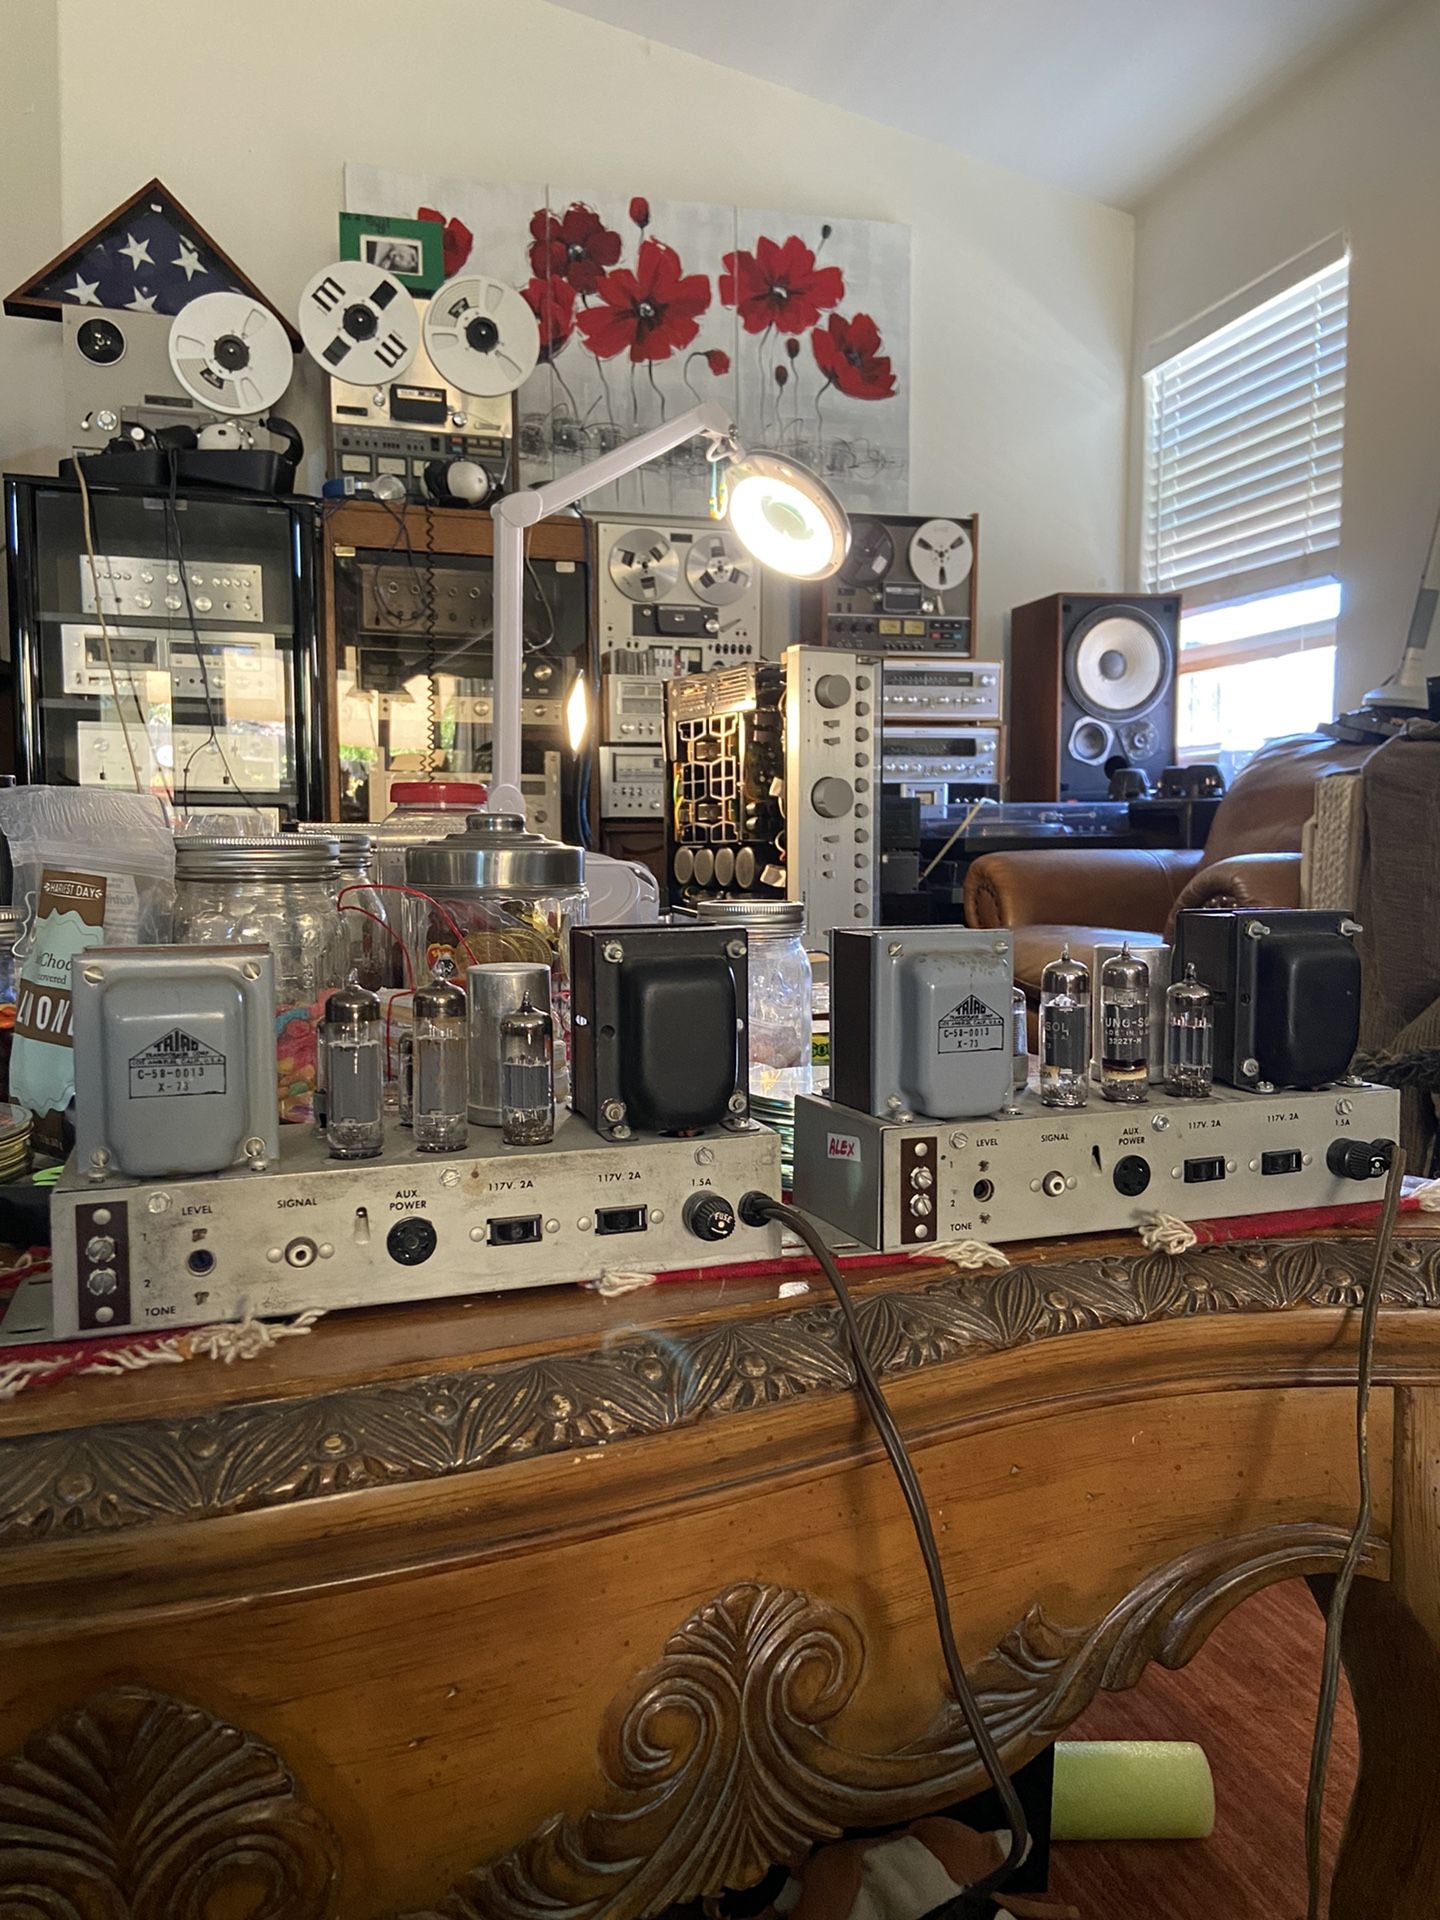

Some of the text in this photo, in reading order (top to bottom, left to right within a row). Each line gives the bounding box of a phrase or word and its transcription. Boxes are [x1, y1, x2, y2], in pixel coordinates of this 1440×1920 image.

[956, 997, 986, 1015] TRIAD
[943, 1027, 990, 1038] C-58-0013
[154, 1030, 199, 1052] TRIAD
[957, 1040, 979, 1048] X-73
[137, 1067, 205, 1080] C-58-0013
[158, 1082, 189, 1092] X-73
[1288, 1113, 1299, 1122] 2A
[1211, 1120, 1222, 1128] 2A
[976, 1138, 998, 1147] LEVEL
[1041, 1133, 1069, 1143] SIGNAL
[1118, 1137, 1145, 1145] POWER
[829, 1137, 855, 1157] ALEX
[626, 1171, 641, 1181] 2A
[520, 1180, 534, 1189] 2A
[277, 1198, 318, 1209] SIGNAL
[389, 1200, 427, 1211] POWER
[950, 1199, 956, 1207] 2
[182, 1205, 213, 1216] LEVEL
[714, 1212, 732, 1223] FUSE
[950, 1222, 972, 1232] TONE
[144, 1280, 151, 1288] 2
[145, 1306, 176, 1317] TONE
